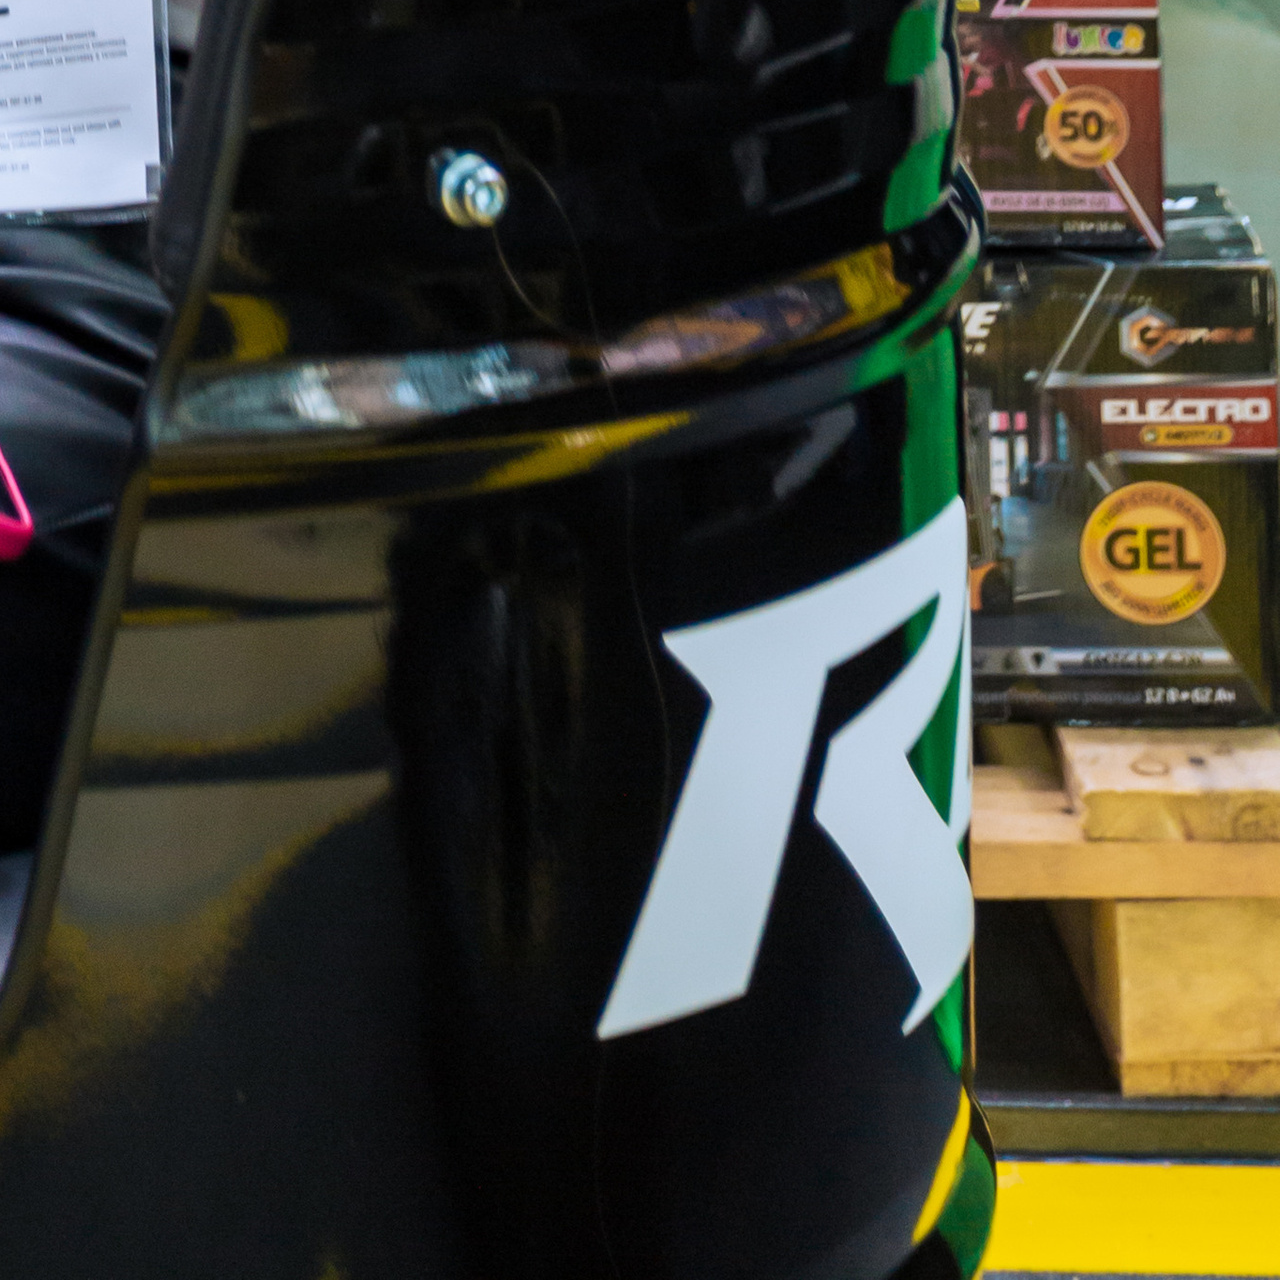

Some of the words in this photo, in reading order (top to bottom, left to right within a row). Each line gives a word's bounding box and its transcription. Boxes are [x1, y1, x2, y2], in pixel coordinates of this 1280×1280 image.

[1058, 110, 1104, 143] 50
[1101, 397, 1271, 425] ELECTRO
[1103, 526, 1203, 572] GEL
